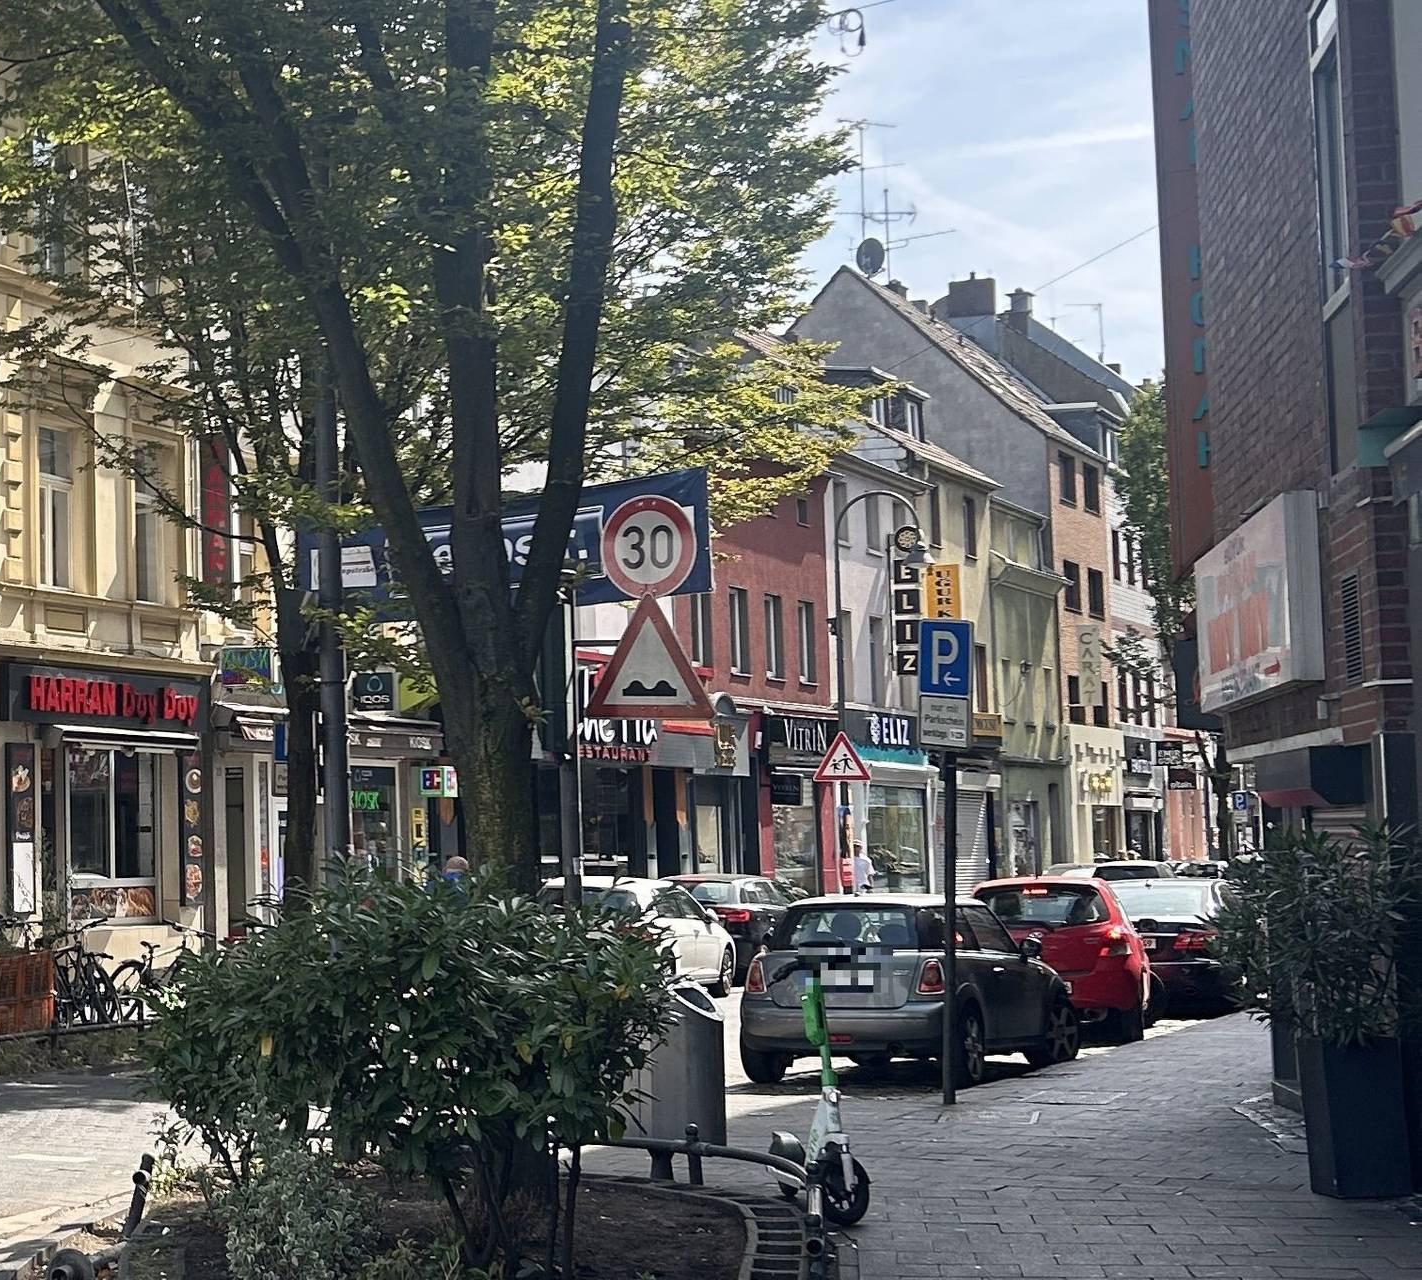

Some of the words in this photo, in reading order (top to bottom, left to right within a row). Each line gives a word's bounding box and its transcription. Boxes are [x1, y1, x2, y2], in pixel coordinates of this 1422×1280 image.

[622, 525, 674, 570] 30
[932, 630, 960, 685] P
[30, 674, 117, 716] HARRAN
[164, 685, 199, 727] Doy
[360, 695, 390, 704] IQOS
[882, 717, 910, 746] ELIZ
